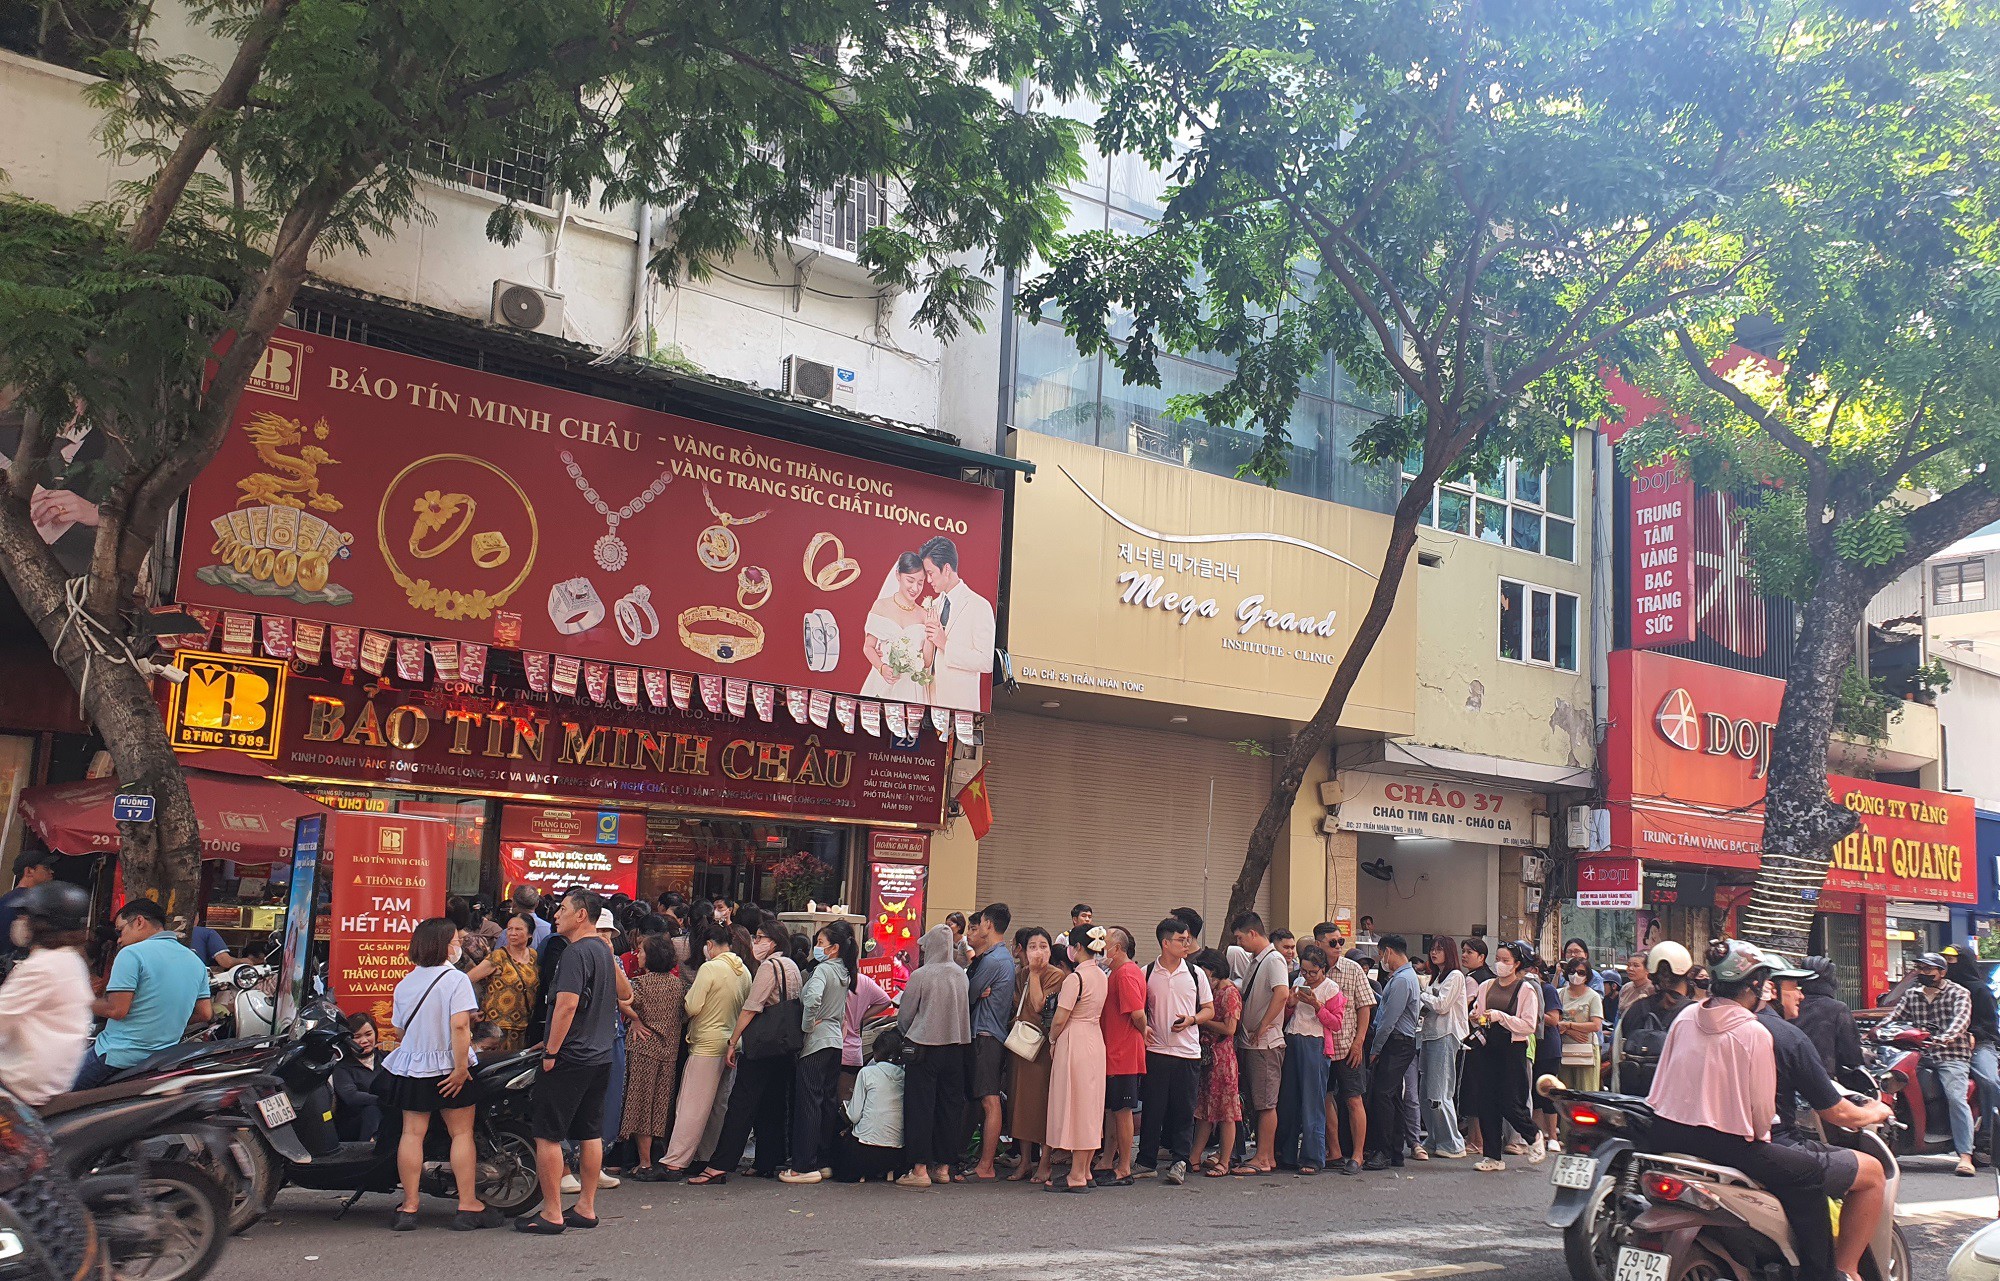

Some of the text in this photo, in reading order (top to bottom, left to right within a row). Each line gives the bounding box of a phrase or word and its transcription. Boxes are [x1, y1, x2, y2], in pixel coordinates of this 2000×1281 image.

[270, 382, 290, 392] 1989
[329, 365, 641, 452] BẢO TÍN MINH CHÂU
[673, 435, 893, 498] VÀNG RỒNG THĂNG LONG
[670, 458, 968, 535] VÀNG TRANG SỨC CHẤT LƯỢNG CAO
[1636, 501, 1681, 526] TRUNG
[1644, 524, 1674, 546] TÂM
[1640, 546, 1678, 569] VÀNG
[1169, 552, 1241, 584] 메가클리닉
[1645, 570, 1673, 592] BẠC
[1116, 570, 1337, 638] Mega Grand
[1636, 591, 1681, 614] TRANG
[1645, 613, 1673, 635] SỨC
[1222, 637, 1335, 665] INSTITUTE CLINIC
[1022, 666, 1038, 680] ĐỊA
[1059, 672, 1069, 683] 35
[1072, 671, 1095, 687] TRẦN
[1097, 677, 1120, 690] NHÂN
[1121, 679, 1145, 693] TÔNG
[489, 685, 508, 697] TY
[513, 687, 549, 702] TNHH
[182, 729, 264, 748] BTMC 1989
[303, 684, 856, 789] BẢO TÍN MINH CHÂU
[896, 734, 917, 748] 29
[868, 752, 936, 767] TRẦN NHÂN TÔNG
[290, 751, 317, 763] KINH
[318, 753, 356, 767] DOANH
[358, 756, 387, 769] VÀNG
[389, 758, 419, 773] RỒNG
[421, 762, 455, 776] THĂNG
[457, 767, 487, 780] LONG,
[490, 769, 507, 782] SJC
[620, 781, 645, 794] NGHỆ
[880, 768, 892, 778] CỬA
[893, 770, 912, 780] HÀNG
[863, 790, 877, 798] PHỐ
[864, 778, 877, 787] ĐẦU
[894, 781, 907, 790] CỦA
[908, 784, 926, 792] BTMC
[928, 785, 936, 793] VÀ
[881, 802, 897, 810] NĂM
[1384, 782, 1504, 813] CHÁO 37
[127, 809, 143, 818] 17
[1845, 789, 1949, 825] CÔNG TY VÀNG
[533, 819, 579, 830] THĂNG LONG
[1372, 805, 1512, 831] CHÁO TIM GAN CHÁO GÀ
[92, 834, 110, 845] 29
[202, 838, 241, 853] TÔNG
[1642, 830, 1749, 855] TRUNG TÂM VÀNG BẠC
[352, 854, 430, 867] BẢO TÍN MINH CHÂU
[534, 850, 565, 862] TRANG
[565, 848, 584, 861] SỨC
[1829, 823, 1887, 880] NHẬT
[1891, 837, 1963, 883] QUANG
[528, 858, 612, 872] CỦA HỒI MÔN BTMC
[366, 873, 426, 887] THÔNG BÁO
[1598, 868, 1630, 886] DOJI
[372, 896, 411, 915] TẠM
[340, 912, 380, 932] HẾT
[358, 941, 394, 951] CÁC SẢN
[358, 953, 388, 966] VÀNG
[862, 963, 892, 974] VUI LÒNG
[342, 968, 408, 980] THĂNG LONG
[349, 982, 394, 992] VÀ VÀNG
[879, 978, 892, 991] XE
[262, 1095, 285, 1113] 29-AV
[266, 1107, 294, 1126] 000.95
